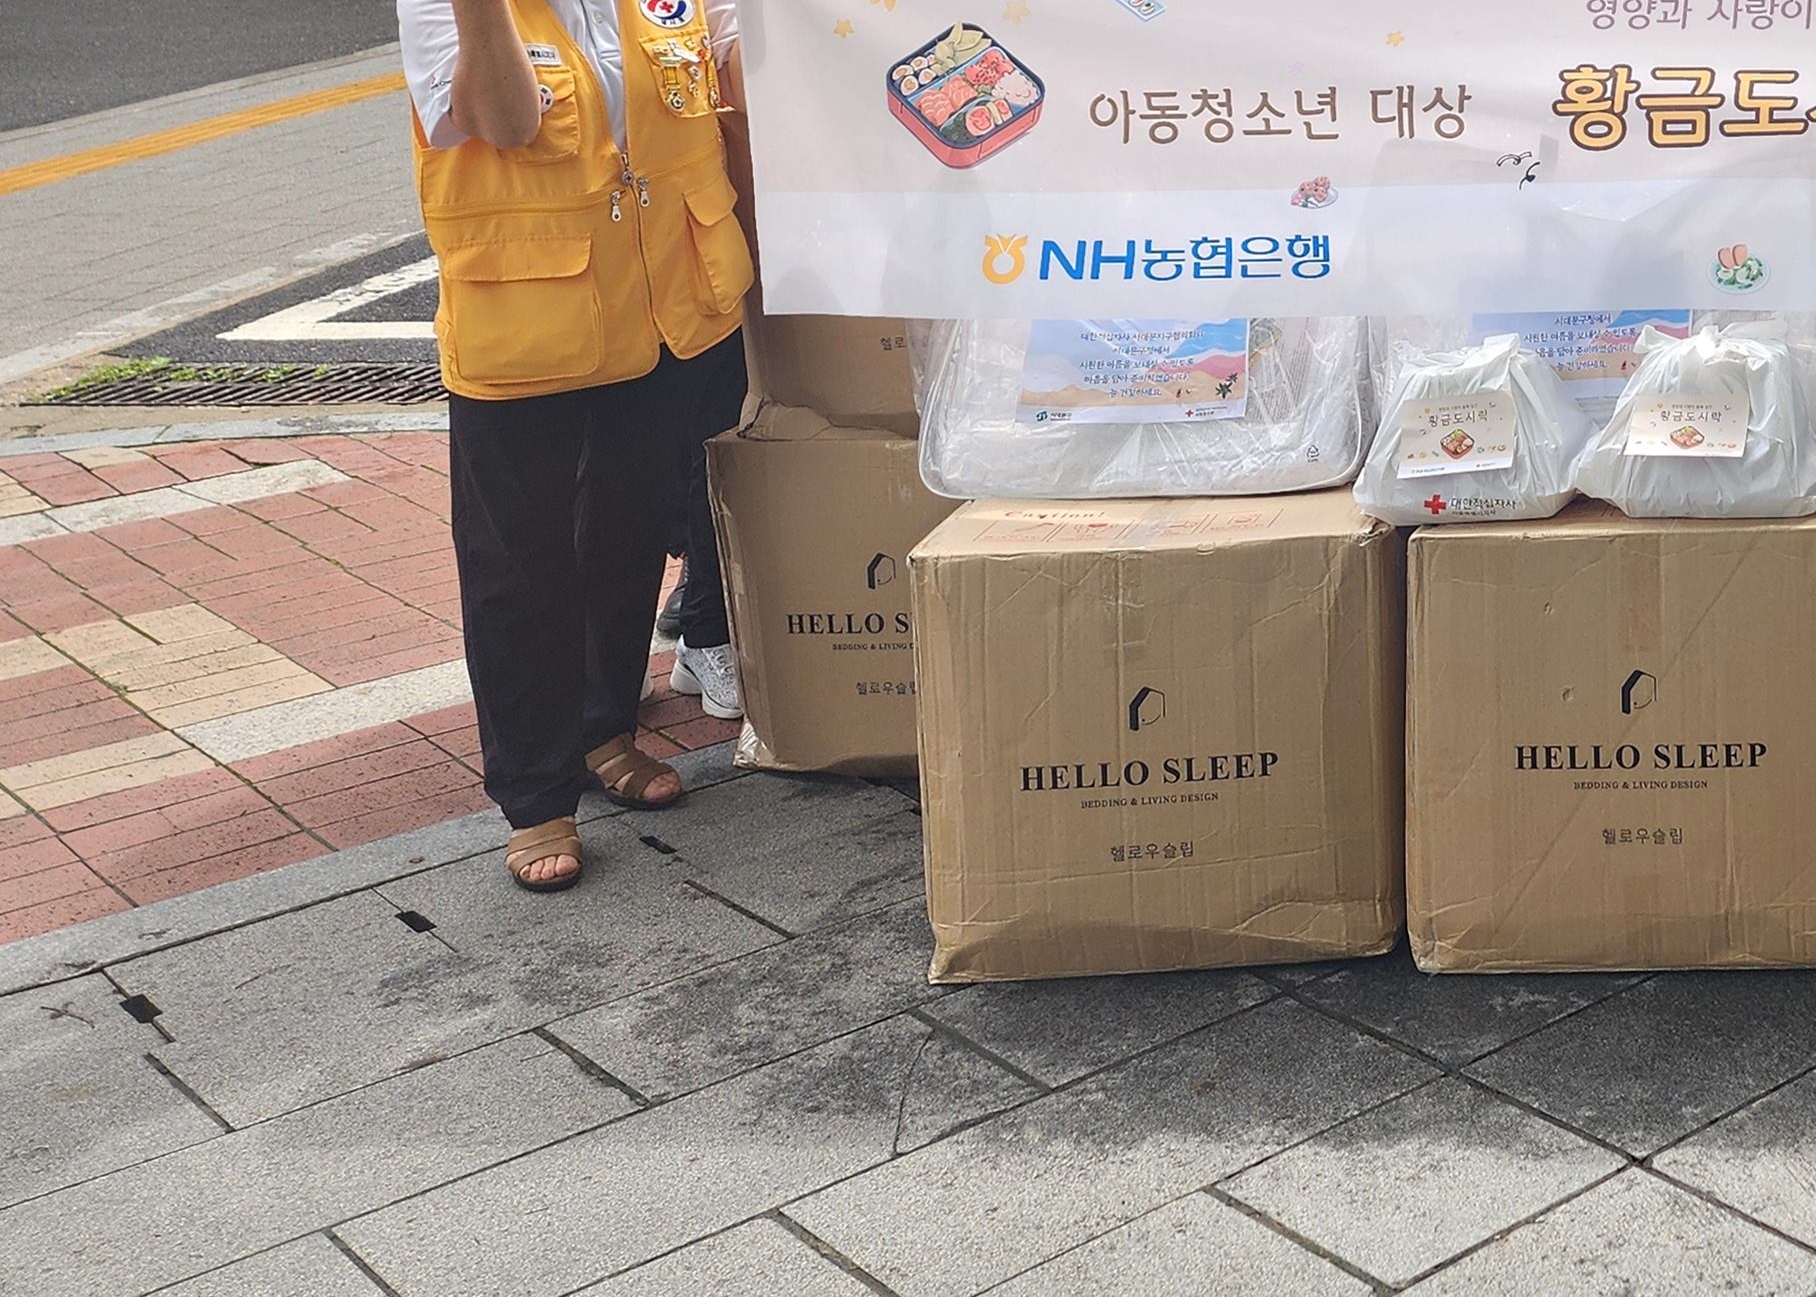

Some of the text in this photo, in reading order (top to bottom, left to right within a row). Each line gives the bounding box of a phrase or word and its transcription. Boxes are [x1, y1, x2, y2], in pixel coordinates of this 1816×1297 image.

[1089, 85, 1341, 146] 아동청소년
[1370, 83, 1473, 141] 대상
[1038, 234, 1331, 284] NH농협은행
[787, 613, 916, 635] HELLO S
[1514, 742, 1768, 771] HELLO SLEEP
[1019, 750, 1280, 793] HELLO SLEEP
[1573, 779, 1709, 790] BEDDING & LIVING DESIGN
[1080, 791, 1219, 810] BEDDING & LIVING DESIGN
[1602, 826, 1684, 846] 헬로우슬립
[1110, 840, 1195, 862] 헬로우슬립
